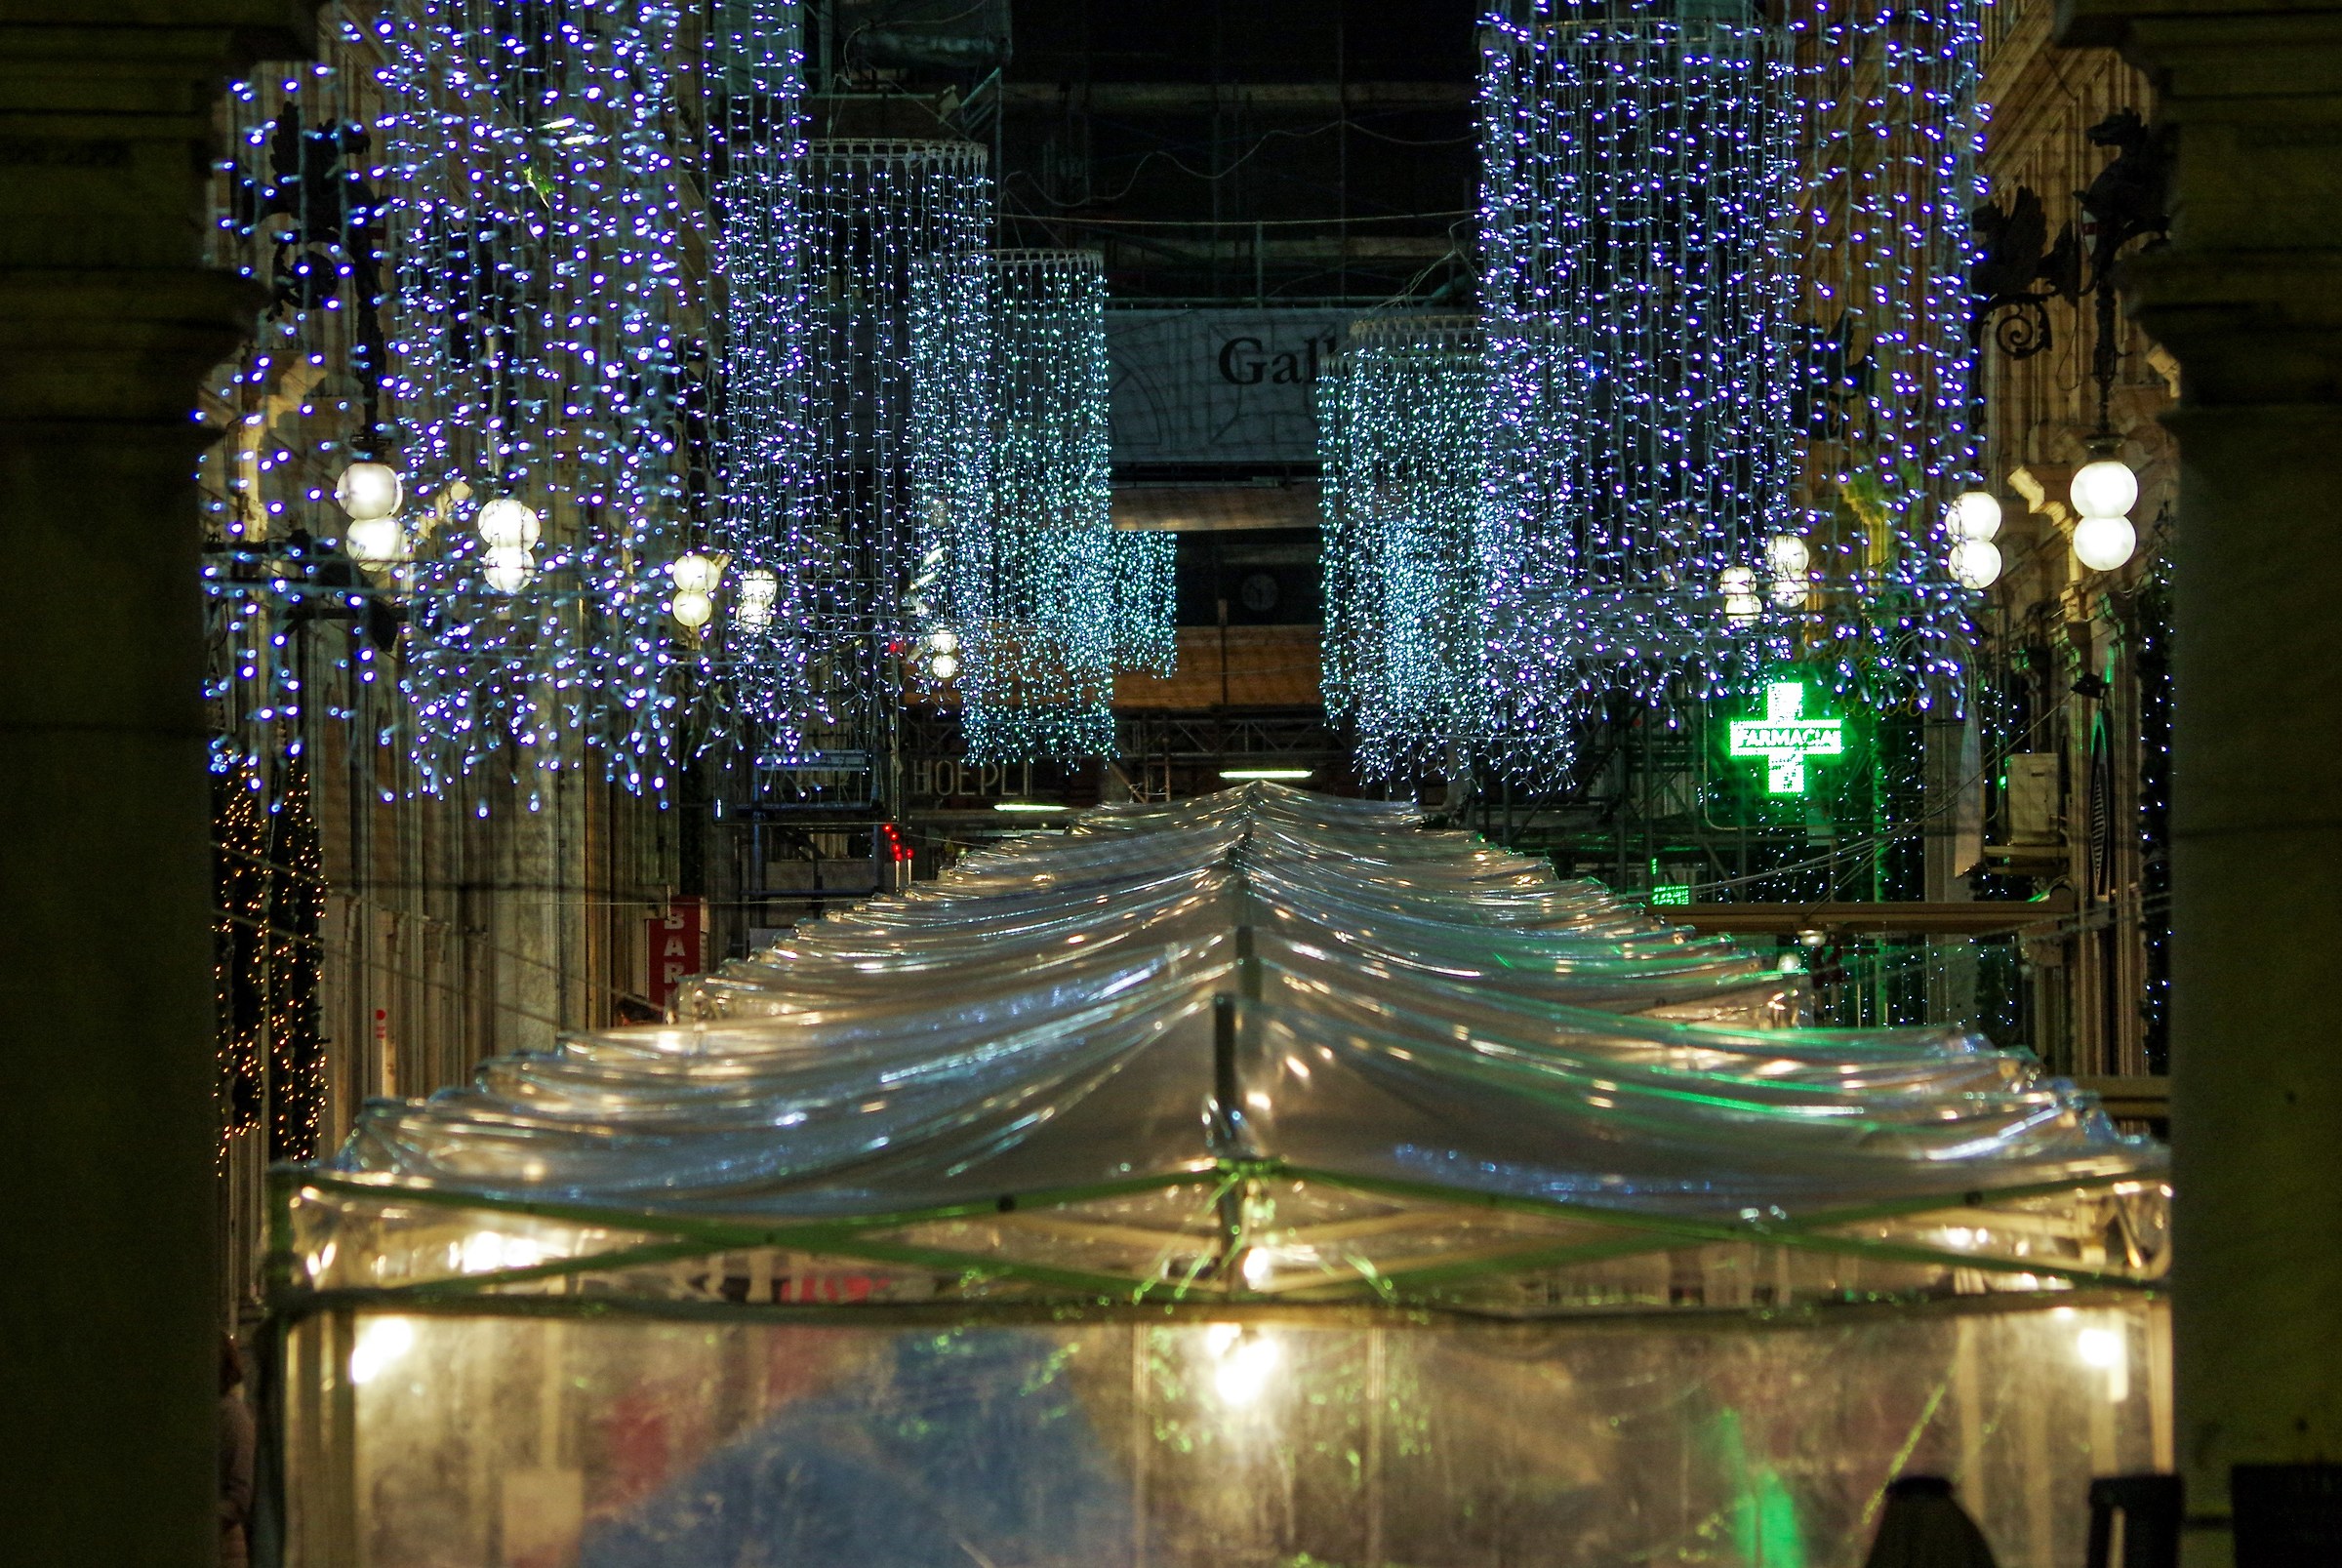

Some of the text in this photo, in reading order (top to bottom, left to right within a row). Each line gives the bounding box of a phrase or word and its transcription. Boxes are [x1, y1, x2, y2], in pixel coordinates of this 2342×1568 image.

[1737, 727, 1837, 748] FARMACIA
[913, 759, 1032, 796] HOEPLI
[664, 906, 686, 985] BAR
